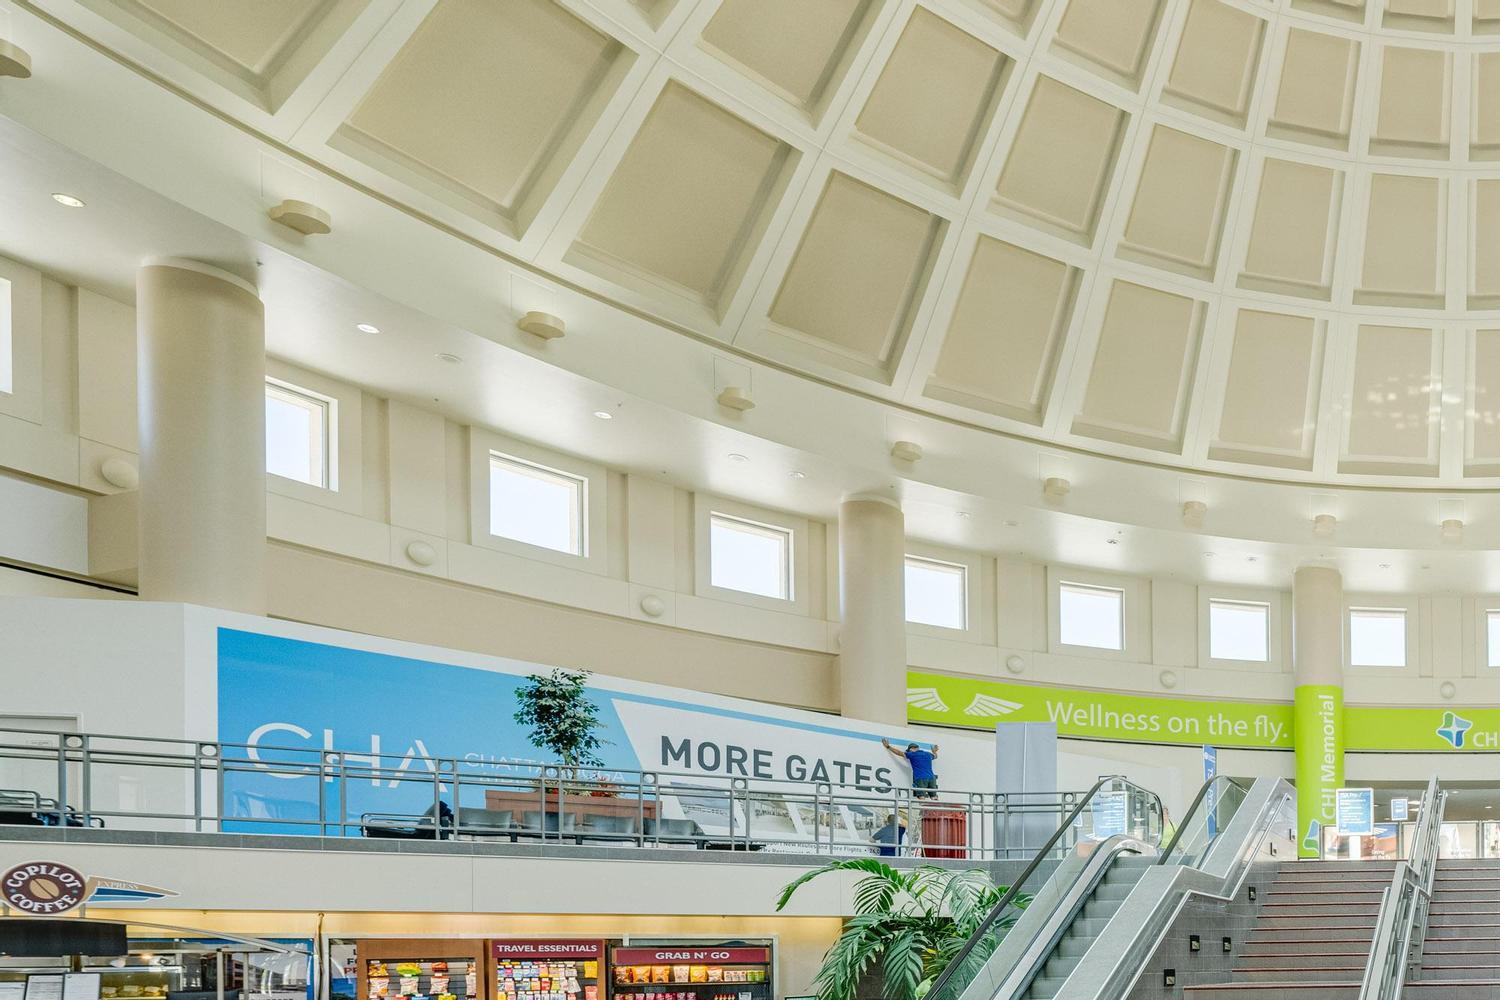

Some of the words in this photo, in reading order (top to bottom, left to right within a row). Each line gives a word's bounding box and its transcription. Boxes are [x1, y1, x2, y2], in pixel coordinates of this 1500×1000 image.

[1046, 700, 1160, 732] Wellness
[1167, 716, 1200, 735] on
[1207, 713, 1248, 737] the
[1254, 714, 1288, 744] fly.
[1319, 694, 1336, 782] Memorial
[246, 722, 449, 793] CHA
[660, 735, 773, 780] MORE
[785, 753, 893, 794] GATES
[1321, 788, 1336, 820] CHI
[7, 865, 82, 891] COPILOT
[97, 880, 139, 890] EXPRESS
[10, 893, 78, 912] COFFEE
[655, 952, 691, 960] GRAB
